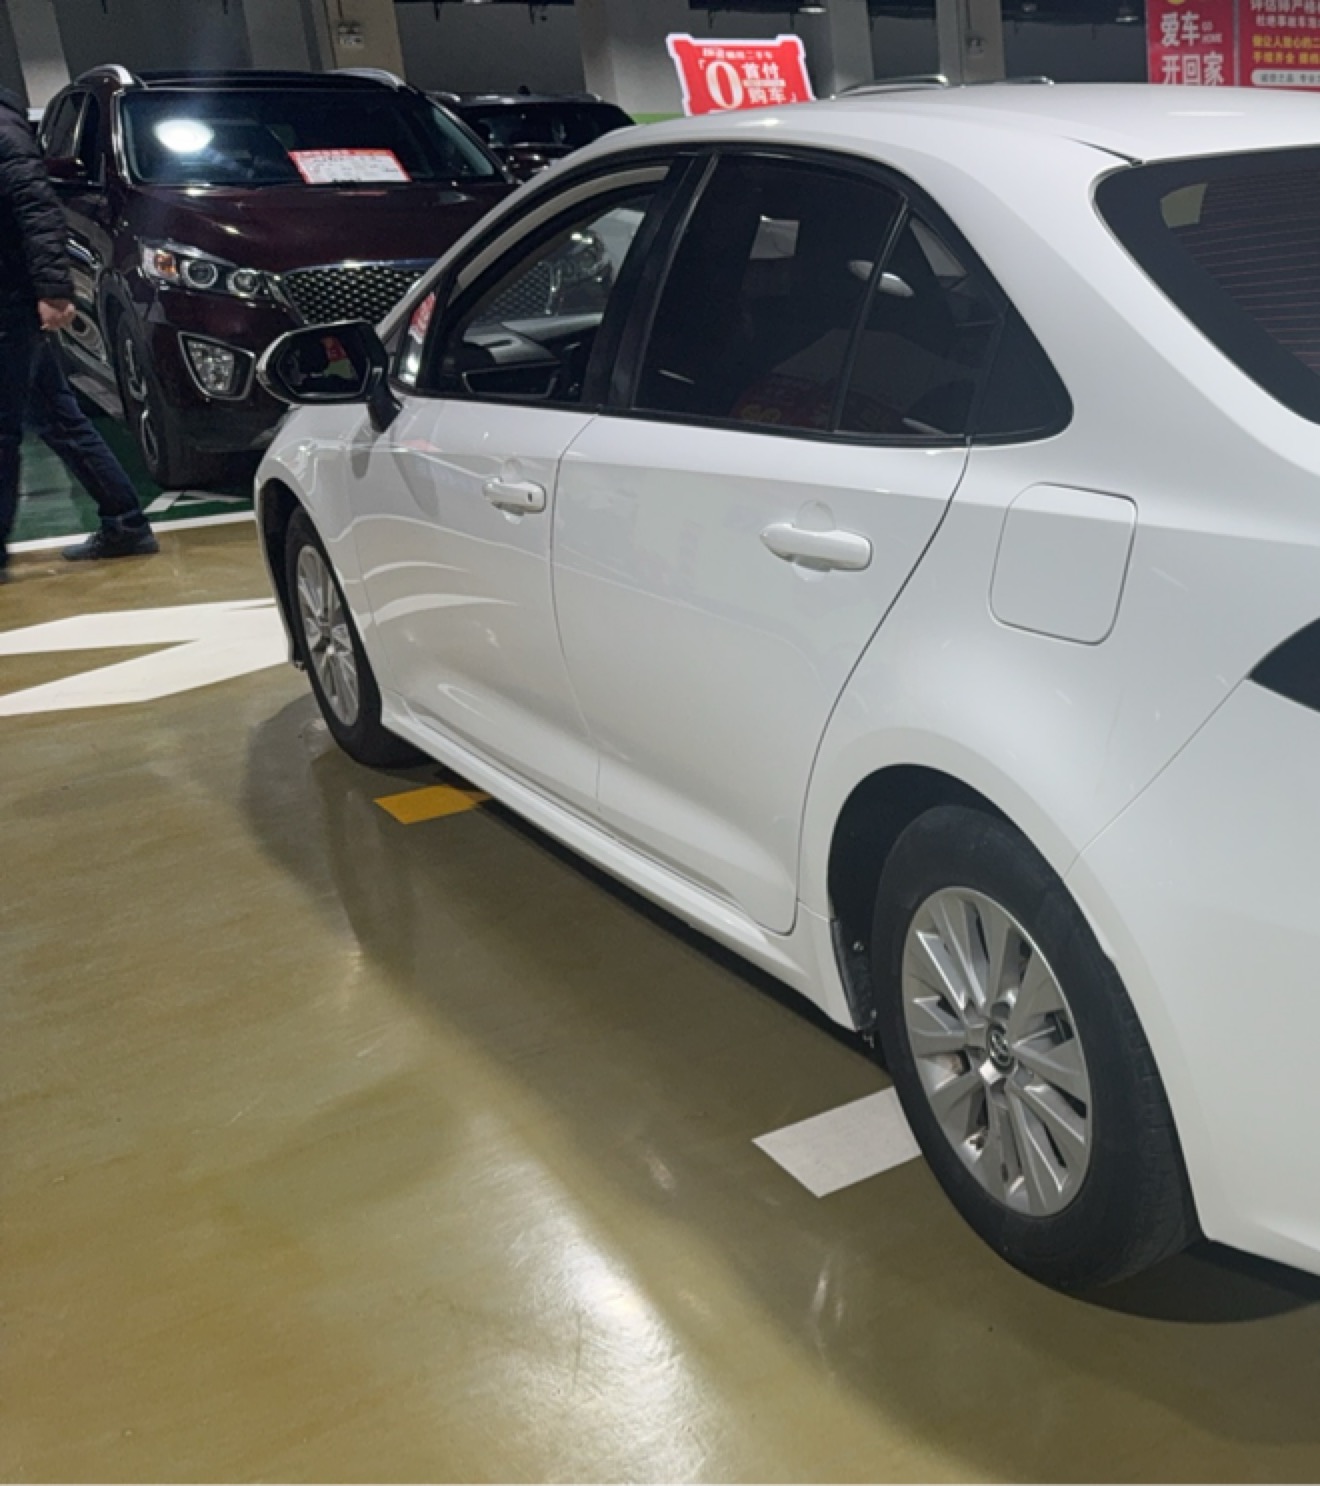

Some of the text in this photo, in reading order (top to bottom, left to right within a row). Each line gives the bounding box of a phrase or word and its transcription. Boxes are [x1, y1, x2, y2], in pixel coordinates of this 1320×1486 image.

[1160, 11, 1200, 47] 爱车
[705, 60, 744, 109] 0
[1161, 51, 1224, 85] 开回家
